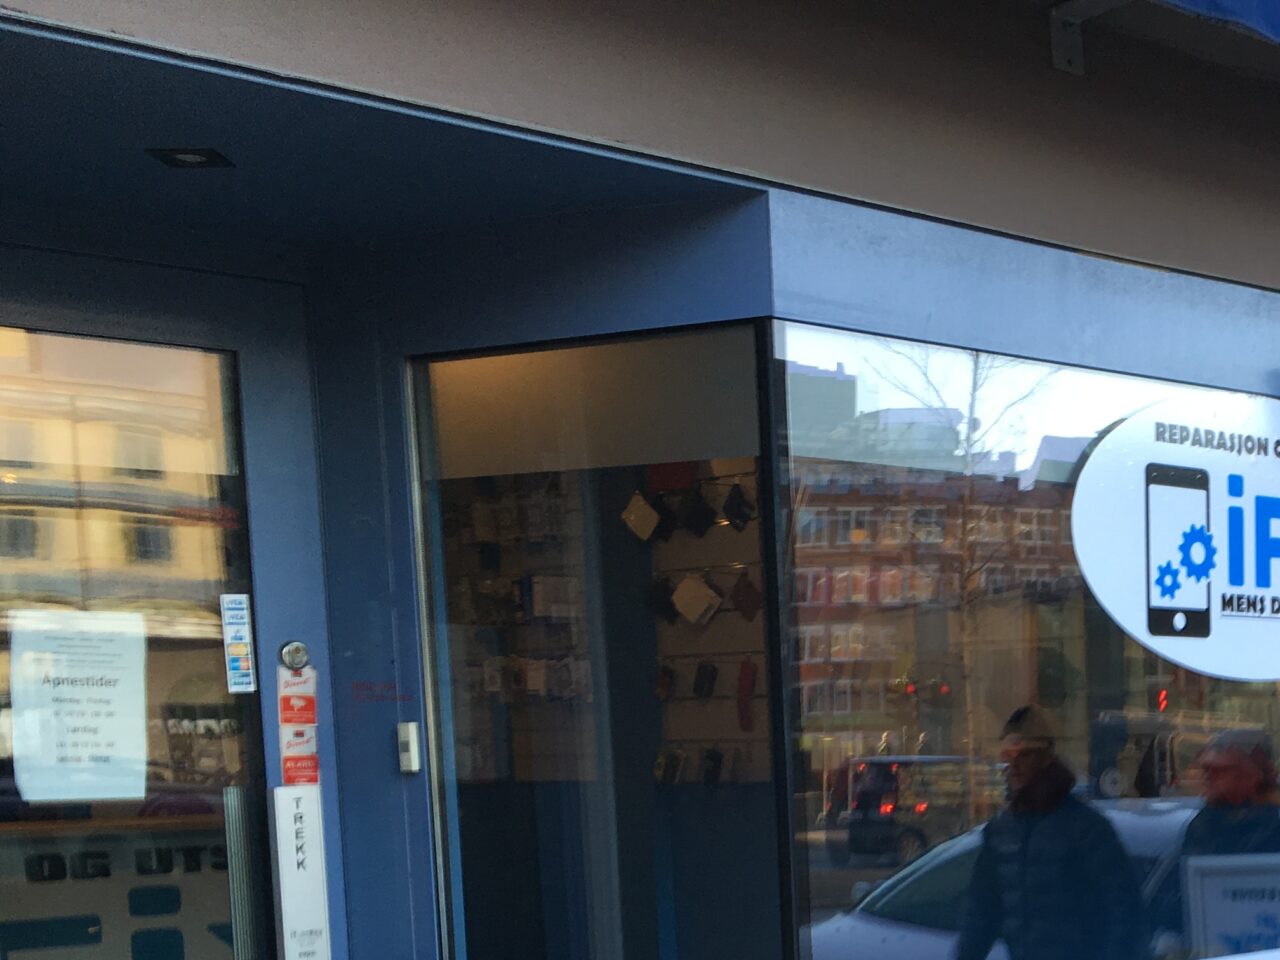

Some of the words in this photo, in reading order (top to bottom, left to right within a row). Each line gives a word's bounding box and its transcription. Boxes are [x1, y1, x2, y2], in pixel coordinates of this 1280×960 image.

[1154, 421, 1269, 457] REPARASJON
[1221, 592, 1265, 615] MENS
[293, 796, 307, 872] TREKK
[24, 851, 112, 882] OG
